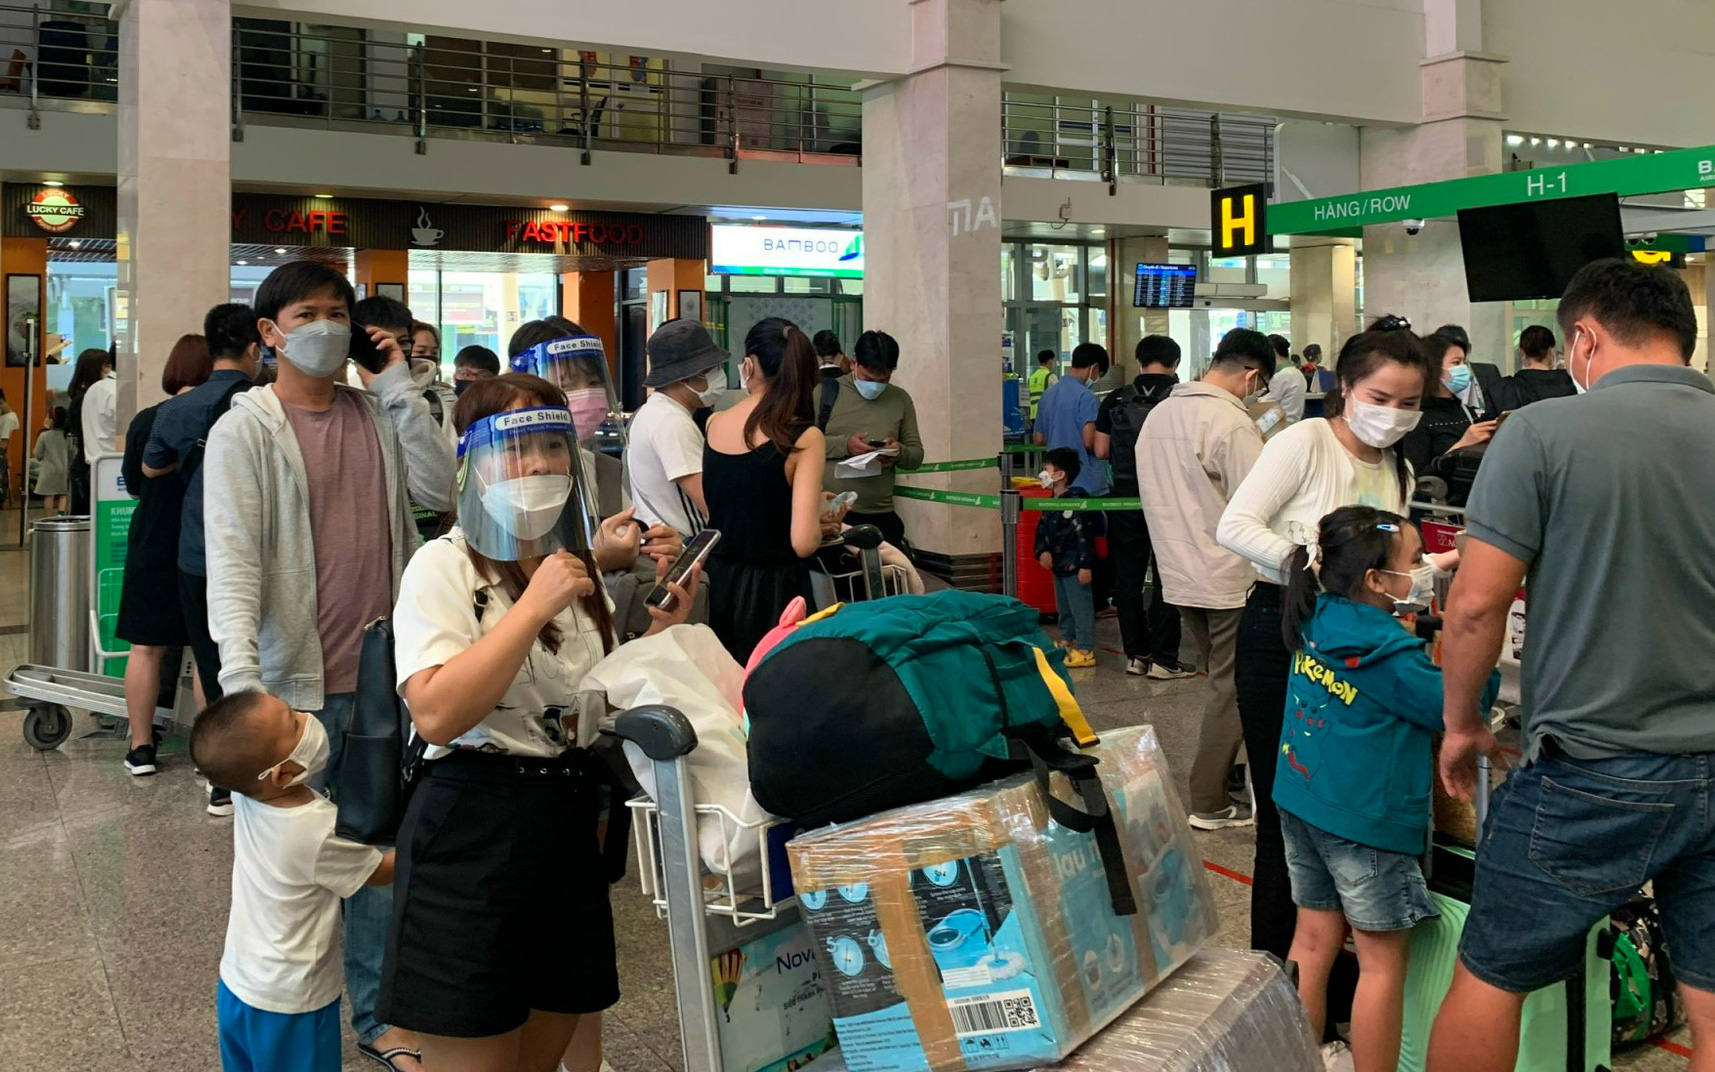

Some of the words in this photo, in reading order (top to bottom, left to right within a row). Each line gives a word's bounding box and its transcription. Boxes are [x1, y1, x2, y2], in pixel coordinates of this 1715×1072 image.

[1698, 160, 1715, 174] B
[1527, 172, 1567, 197] H-1
[26, 205, 59, 214] LUCKY
[59, 207, 84, 216] CAFE
[264, 207, 346, 234] CAFE
[1221, 194, 1255, 248] H
[505, 217, 644, 246] FASTFOOD
[553, 340, 577, 351] Face
[503, 414, 533, 426] Face
[536, 410, 569, 421] Shield
[826, 936, 838, 953] 5
[867, 929, 879, 947] 6
